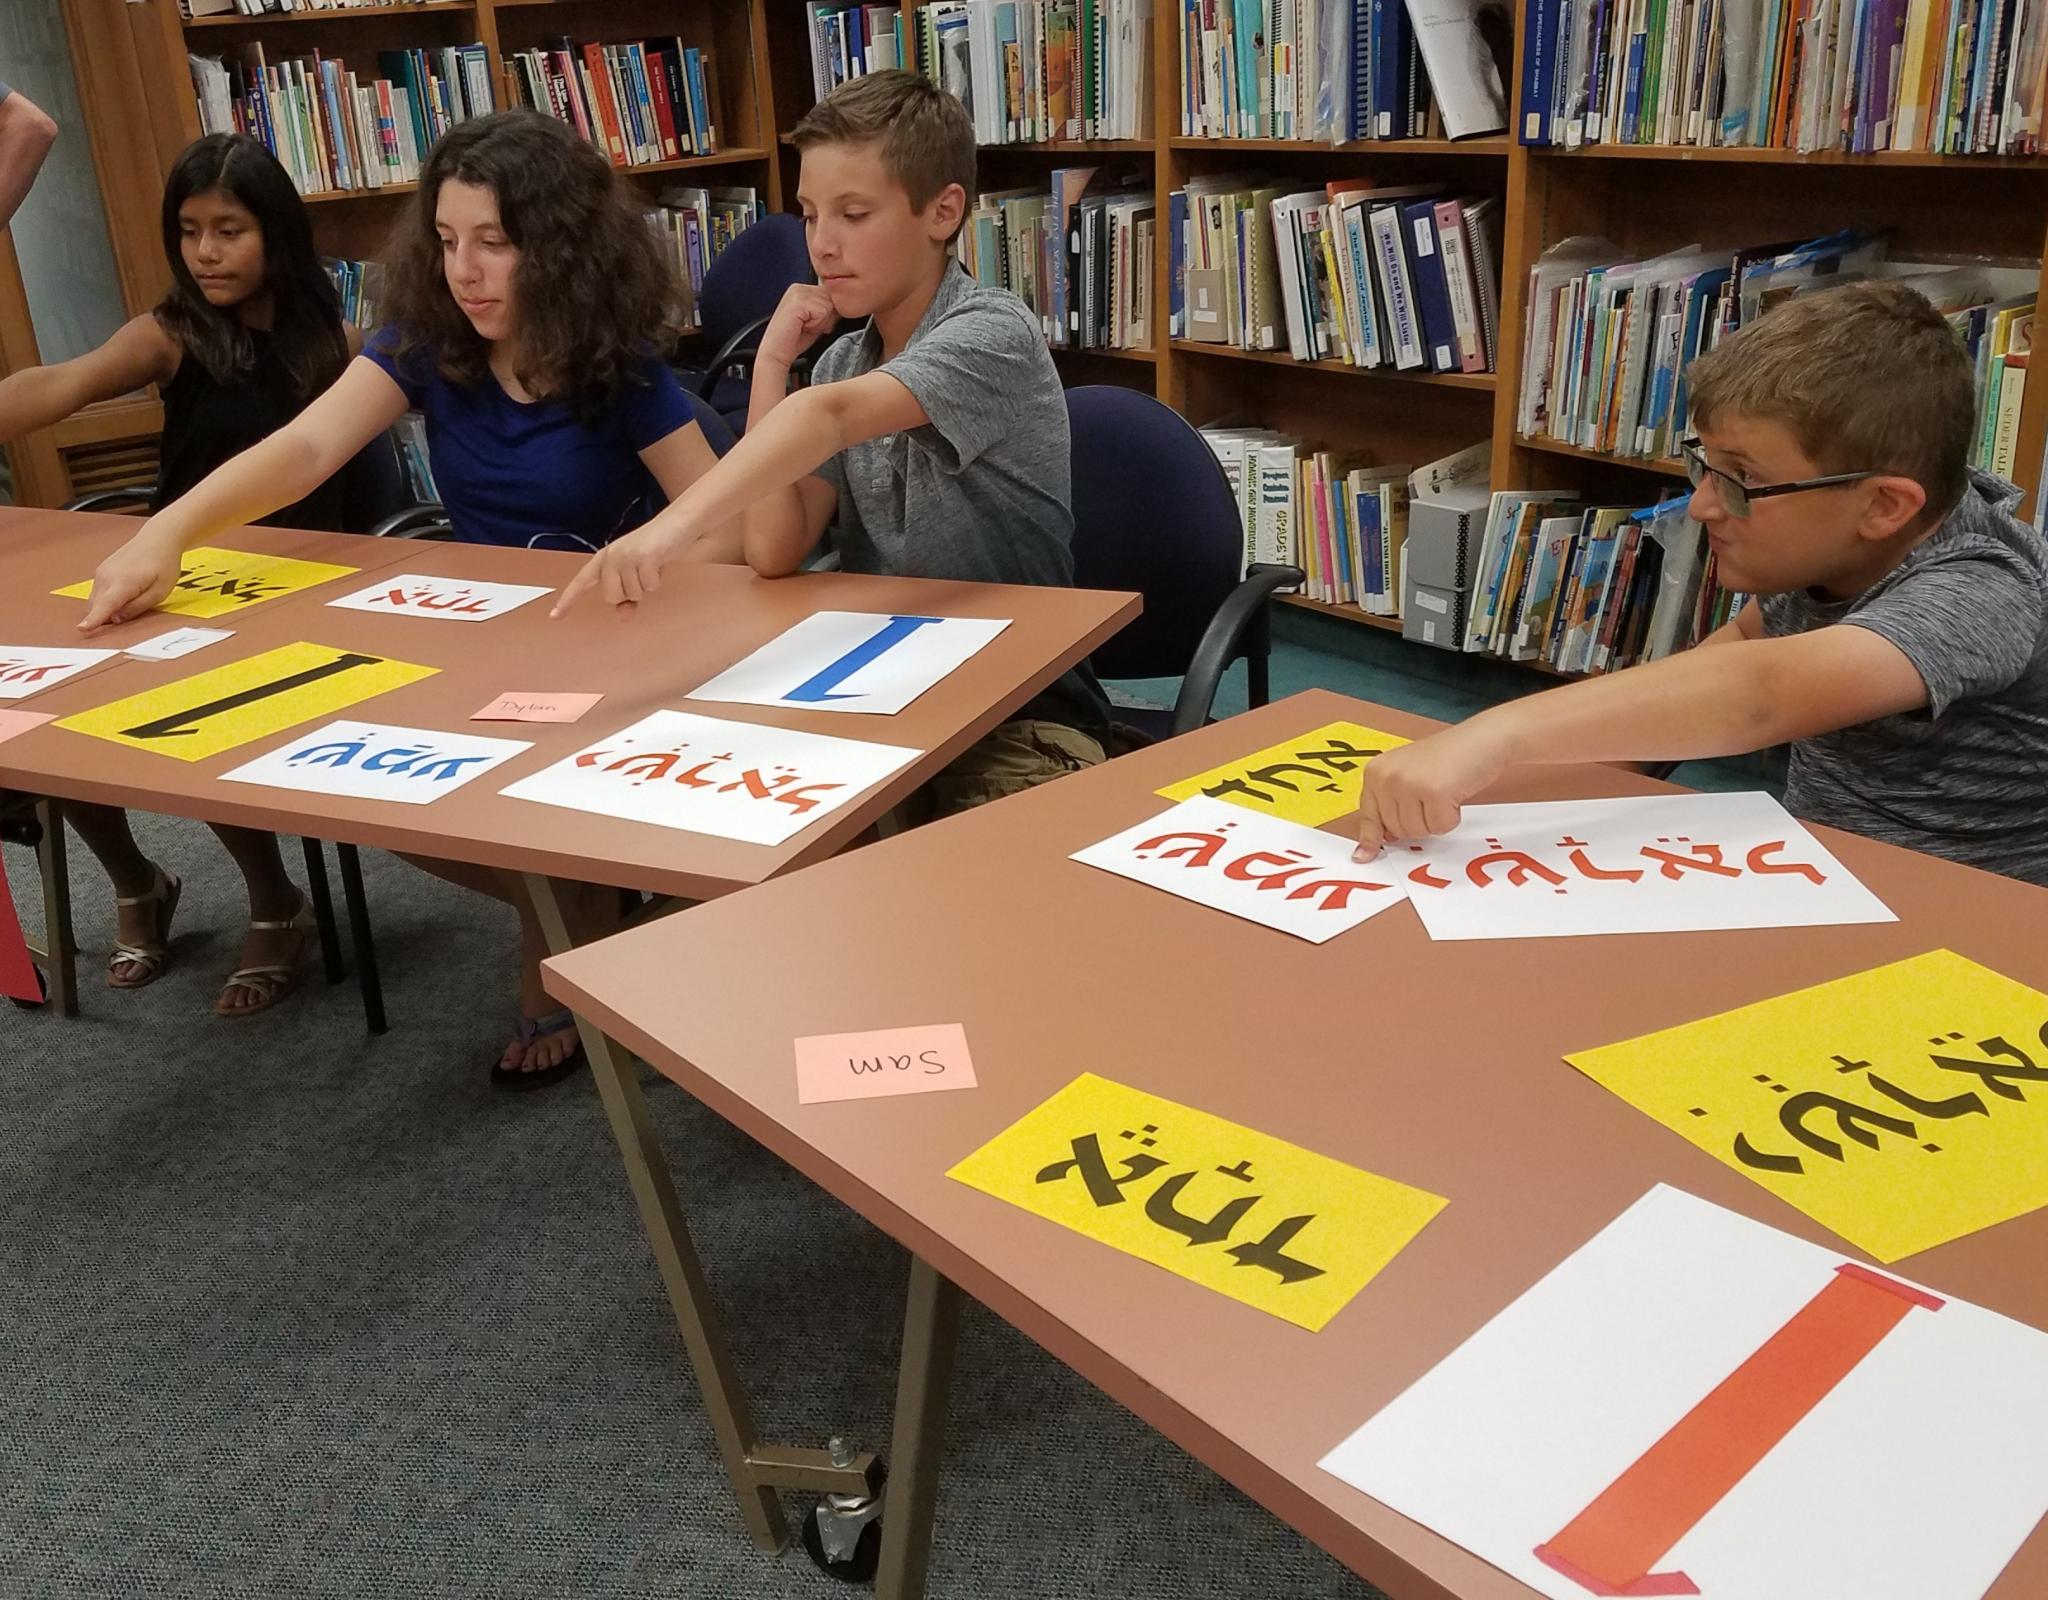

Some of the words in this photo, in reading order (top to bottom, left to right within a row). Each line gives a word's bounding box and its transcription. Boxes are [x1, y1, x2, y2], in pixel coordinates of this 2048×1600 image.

[1535, 13, 1543, 56] SPECIALNESS
[2000, 406, 2014, 444] SEDER
[781, 616, 944, 702] 1
[119, 653, 385, 740] 1
[501, 701, 557, 713] Dylan
[849, 1049, 945, 1075] Sam
[1532, 1262, 1947, 1597] 1
